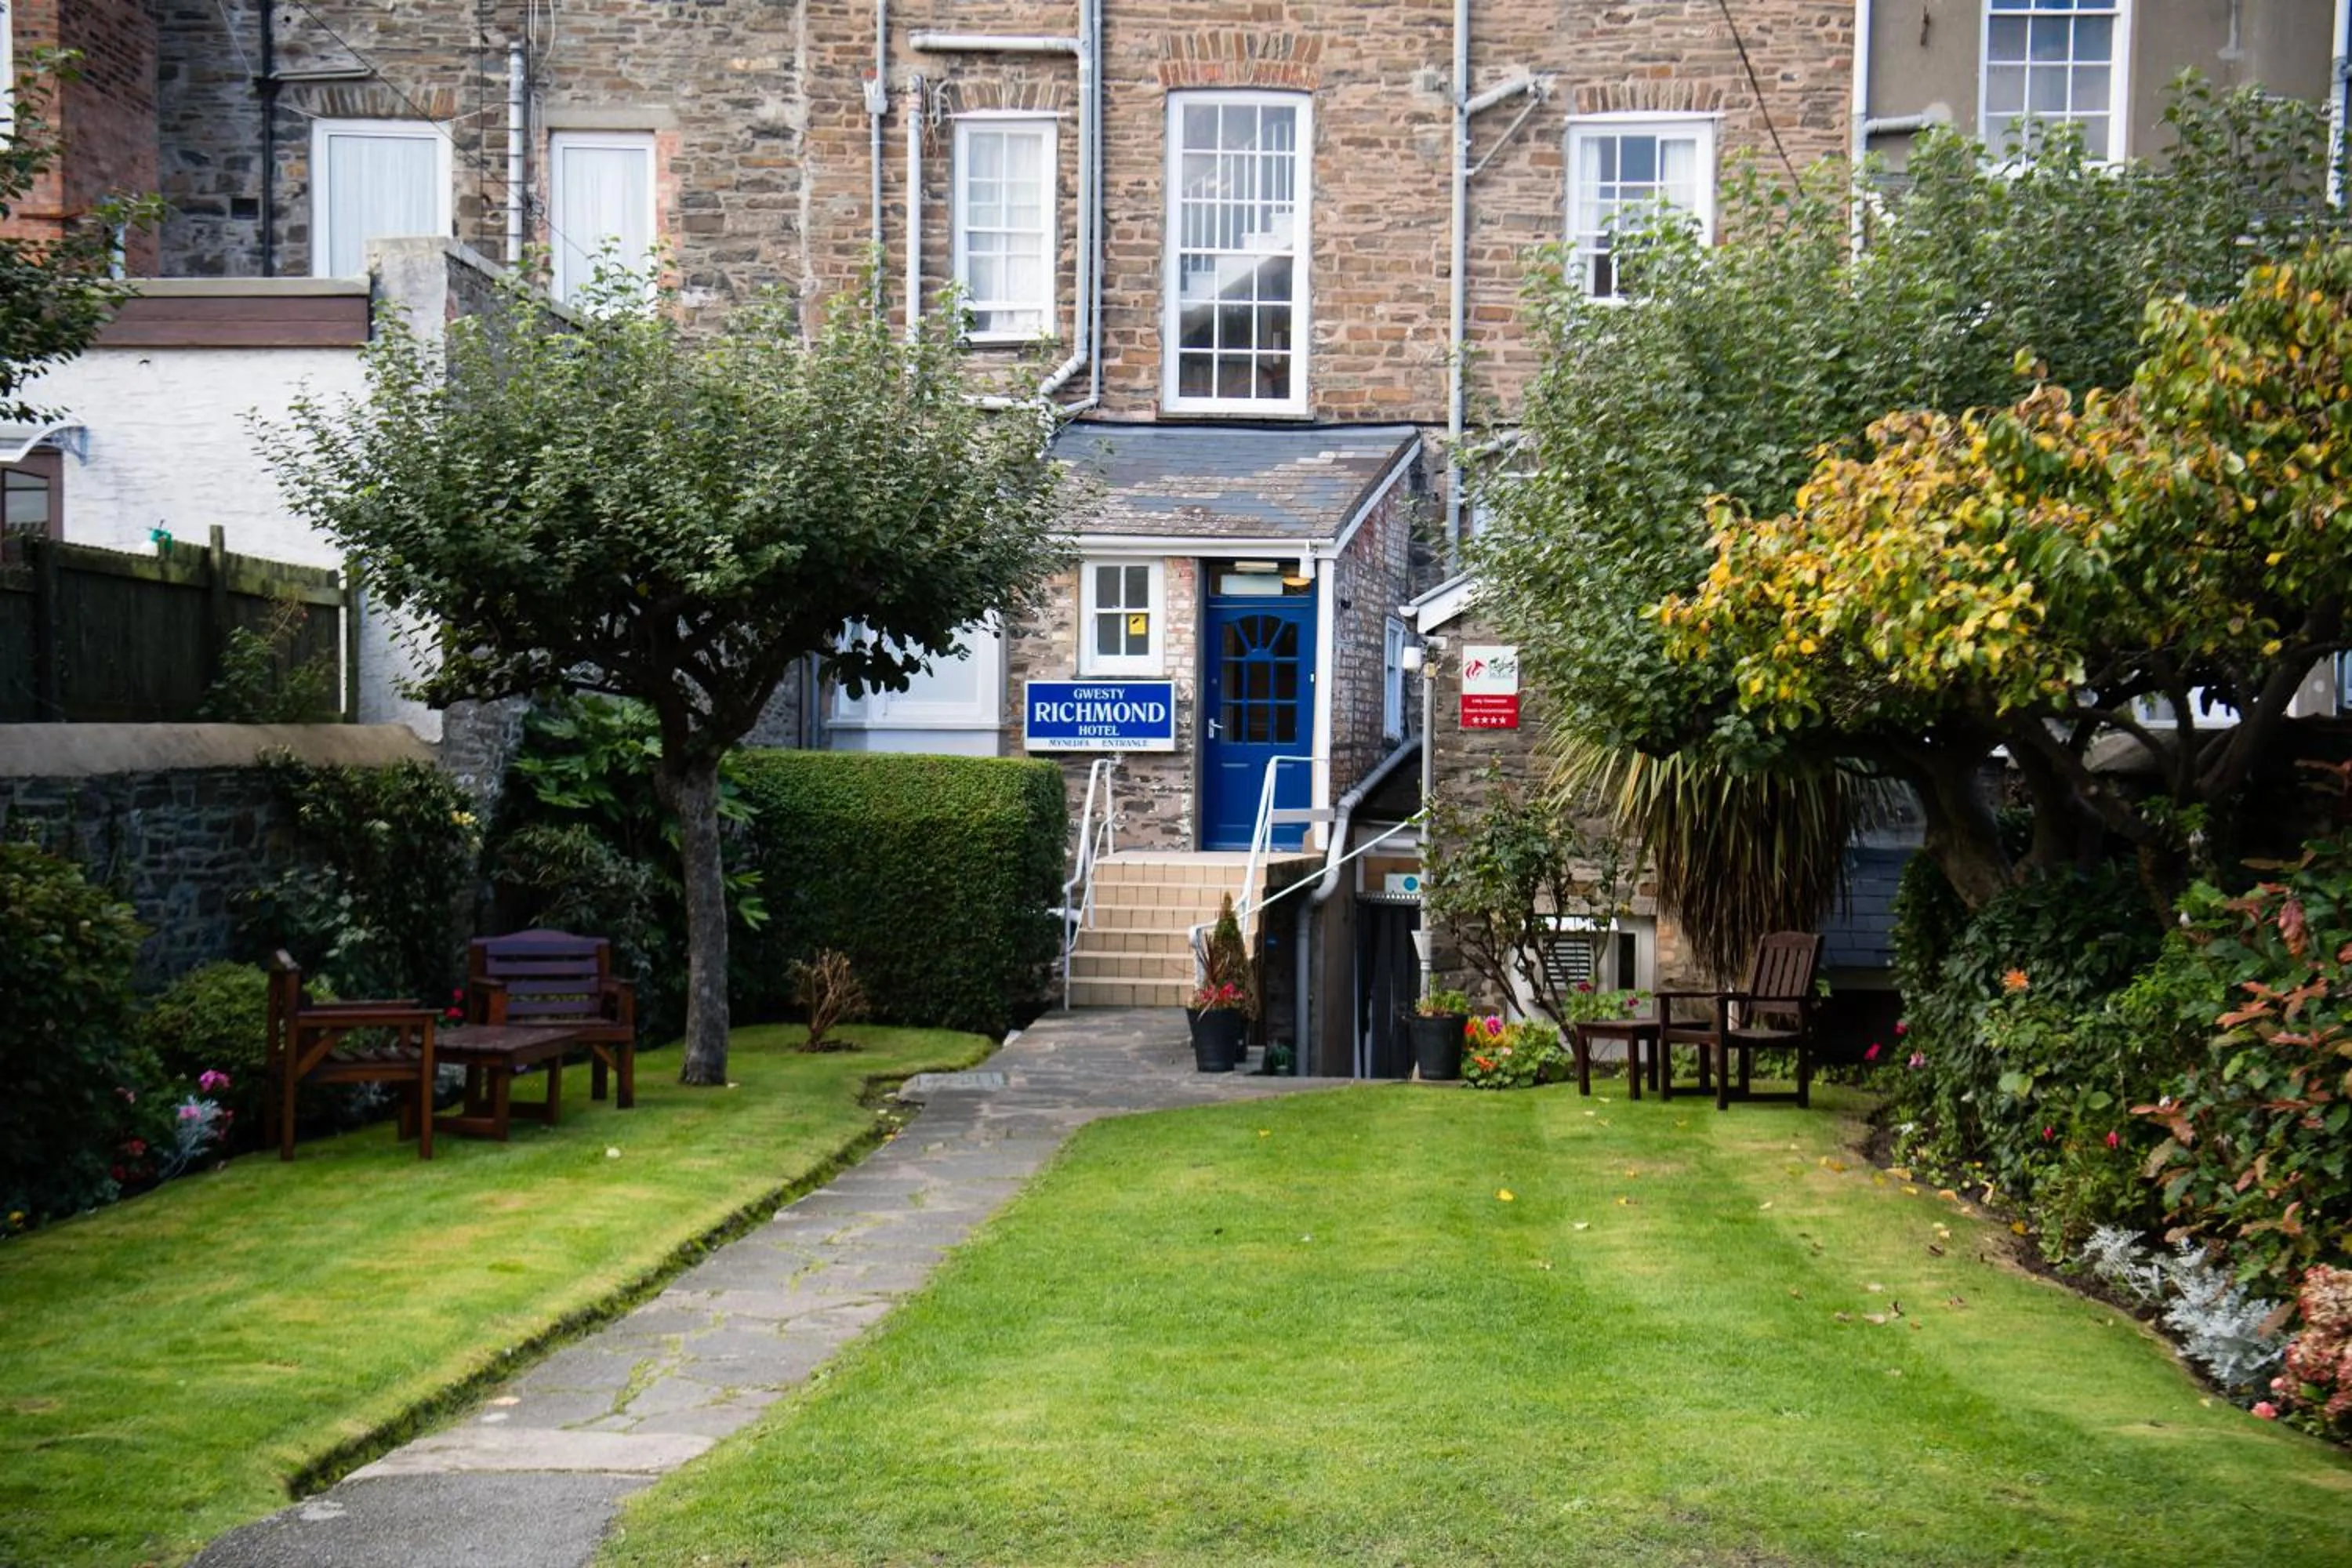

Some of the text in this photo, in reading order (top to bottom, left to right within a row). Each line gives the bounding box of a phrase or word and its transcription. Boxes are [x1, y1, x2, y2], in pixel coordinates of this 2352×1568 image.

[1073, 688, 1125, 700] GWESTY
[1034, 702, 1166, 723] RICHMOND
[1079, 724, 1120, 736] HOTEL
[1102, 739, 1148, 748] ENTRANCE
